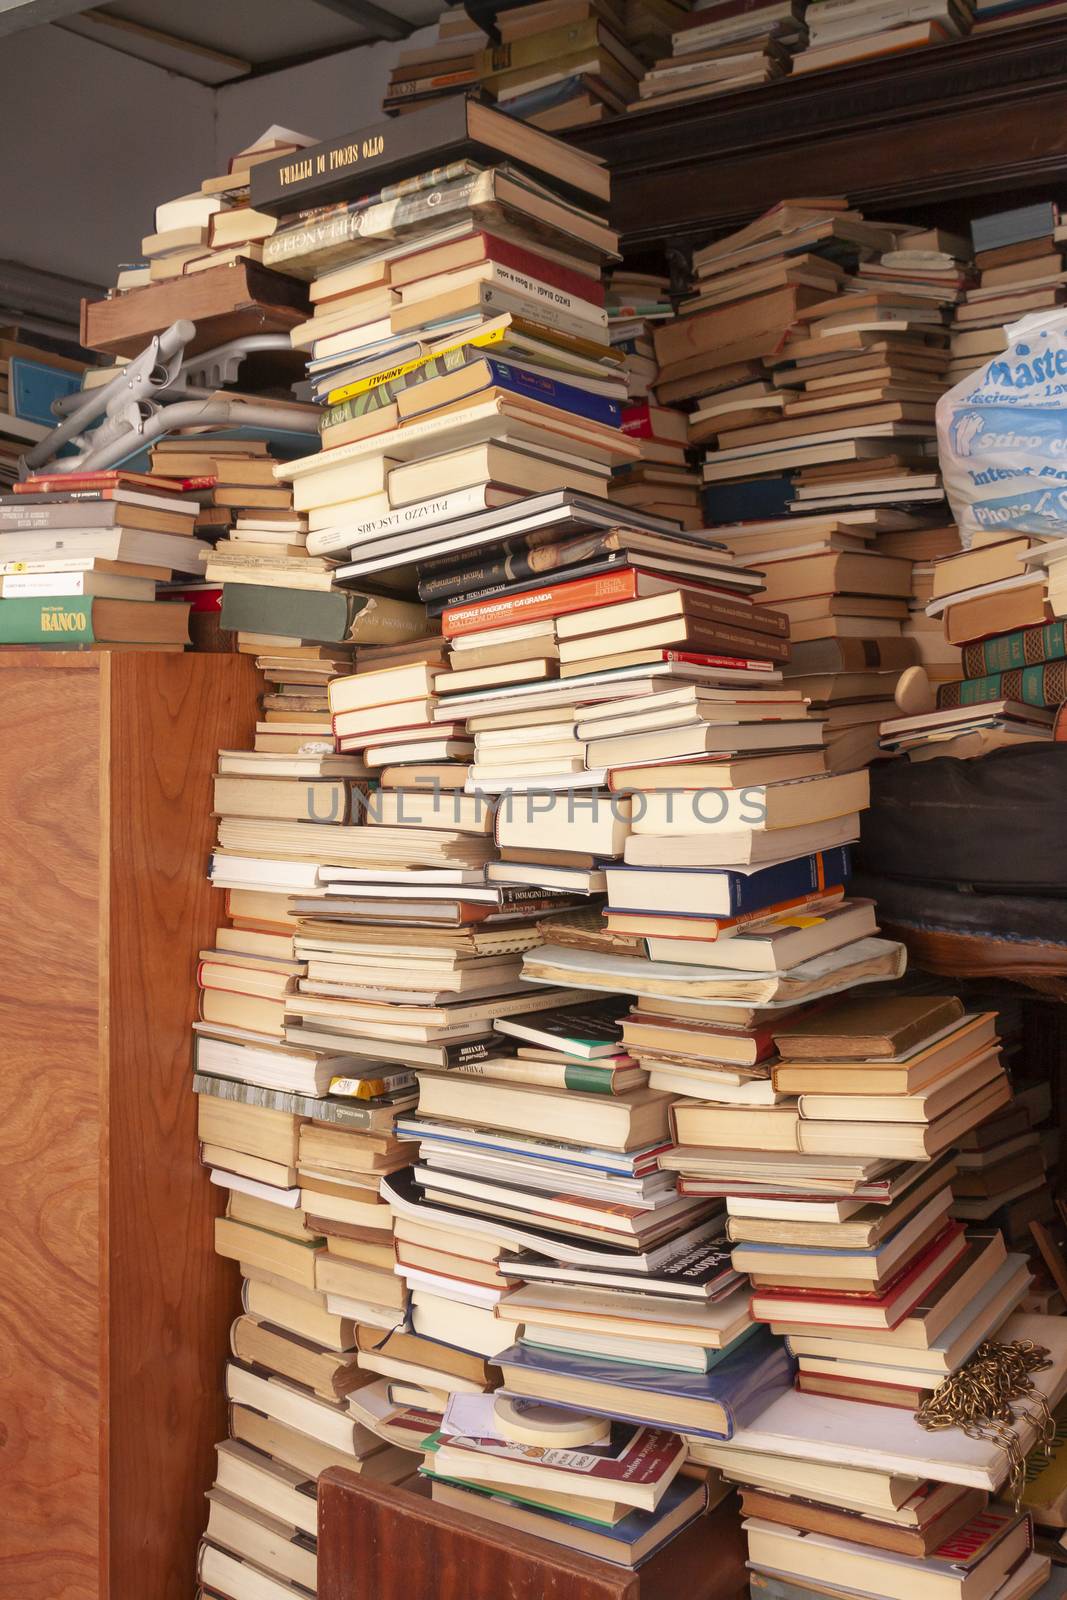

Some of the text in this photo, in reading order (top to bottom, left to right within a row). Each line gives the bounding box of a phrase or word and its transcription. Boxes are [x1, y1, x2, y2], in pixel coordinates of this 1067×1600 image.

[279, 135, 384, 186] OTTO SECOLI DI PITTURA
[537, 286, 554, 300] BIAGI
[555, 294, 571, 308] ENZO
[367, 367, 404, 387] ANIMALI
[978, 431, 1043, 450] Stiro
[357, 500, 448, 535] PALAZZO LASCARIS
[40, 611, 87, 632] BANCO
[448, 608, 480, 623] OSPEDALE
[683, 1252, 732, 1276] Padova
